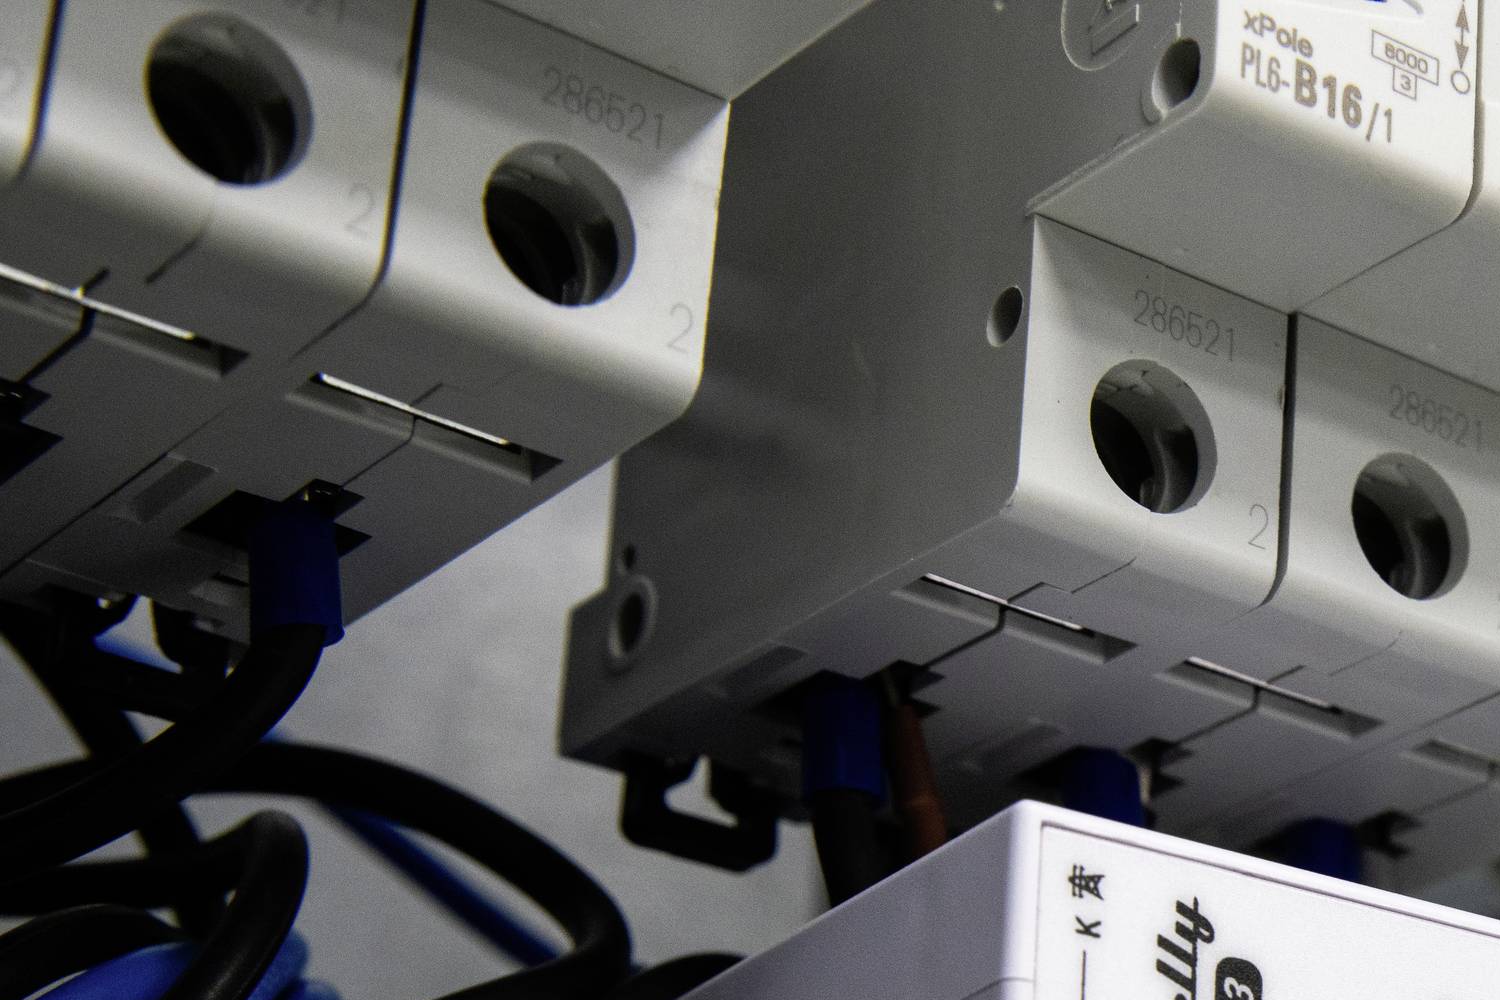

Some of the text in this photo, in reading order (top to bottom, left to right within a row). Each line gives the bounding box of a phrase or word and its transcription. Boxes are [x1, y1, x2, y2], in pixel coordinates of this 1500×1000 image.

[1243, 10, 1313, 58] xPole
[1240, 42, 1393, 143] PL6-B16/1
[1400, 74, 1411, 91] 3
[667, 303, 694, 353] 2
[1133, 289, 1236, 362] 286521
[1388, 385, 1484, 452] 286521
[1248, 503, 1269, 550] 2
[1075, 916, 1102, 938] K
